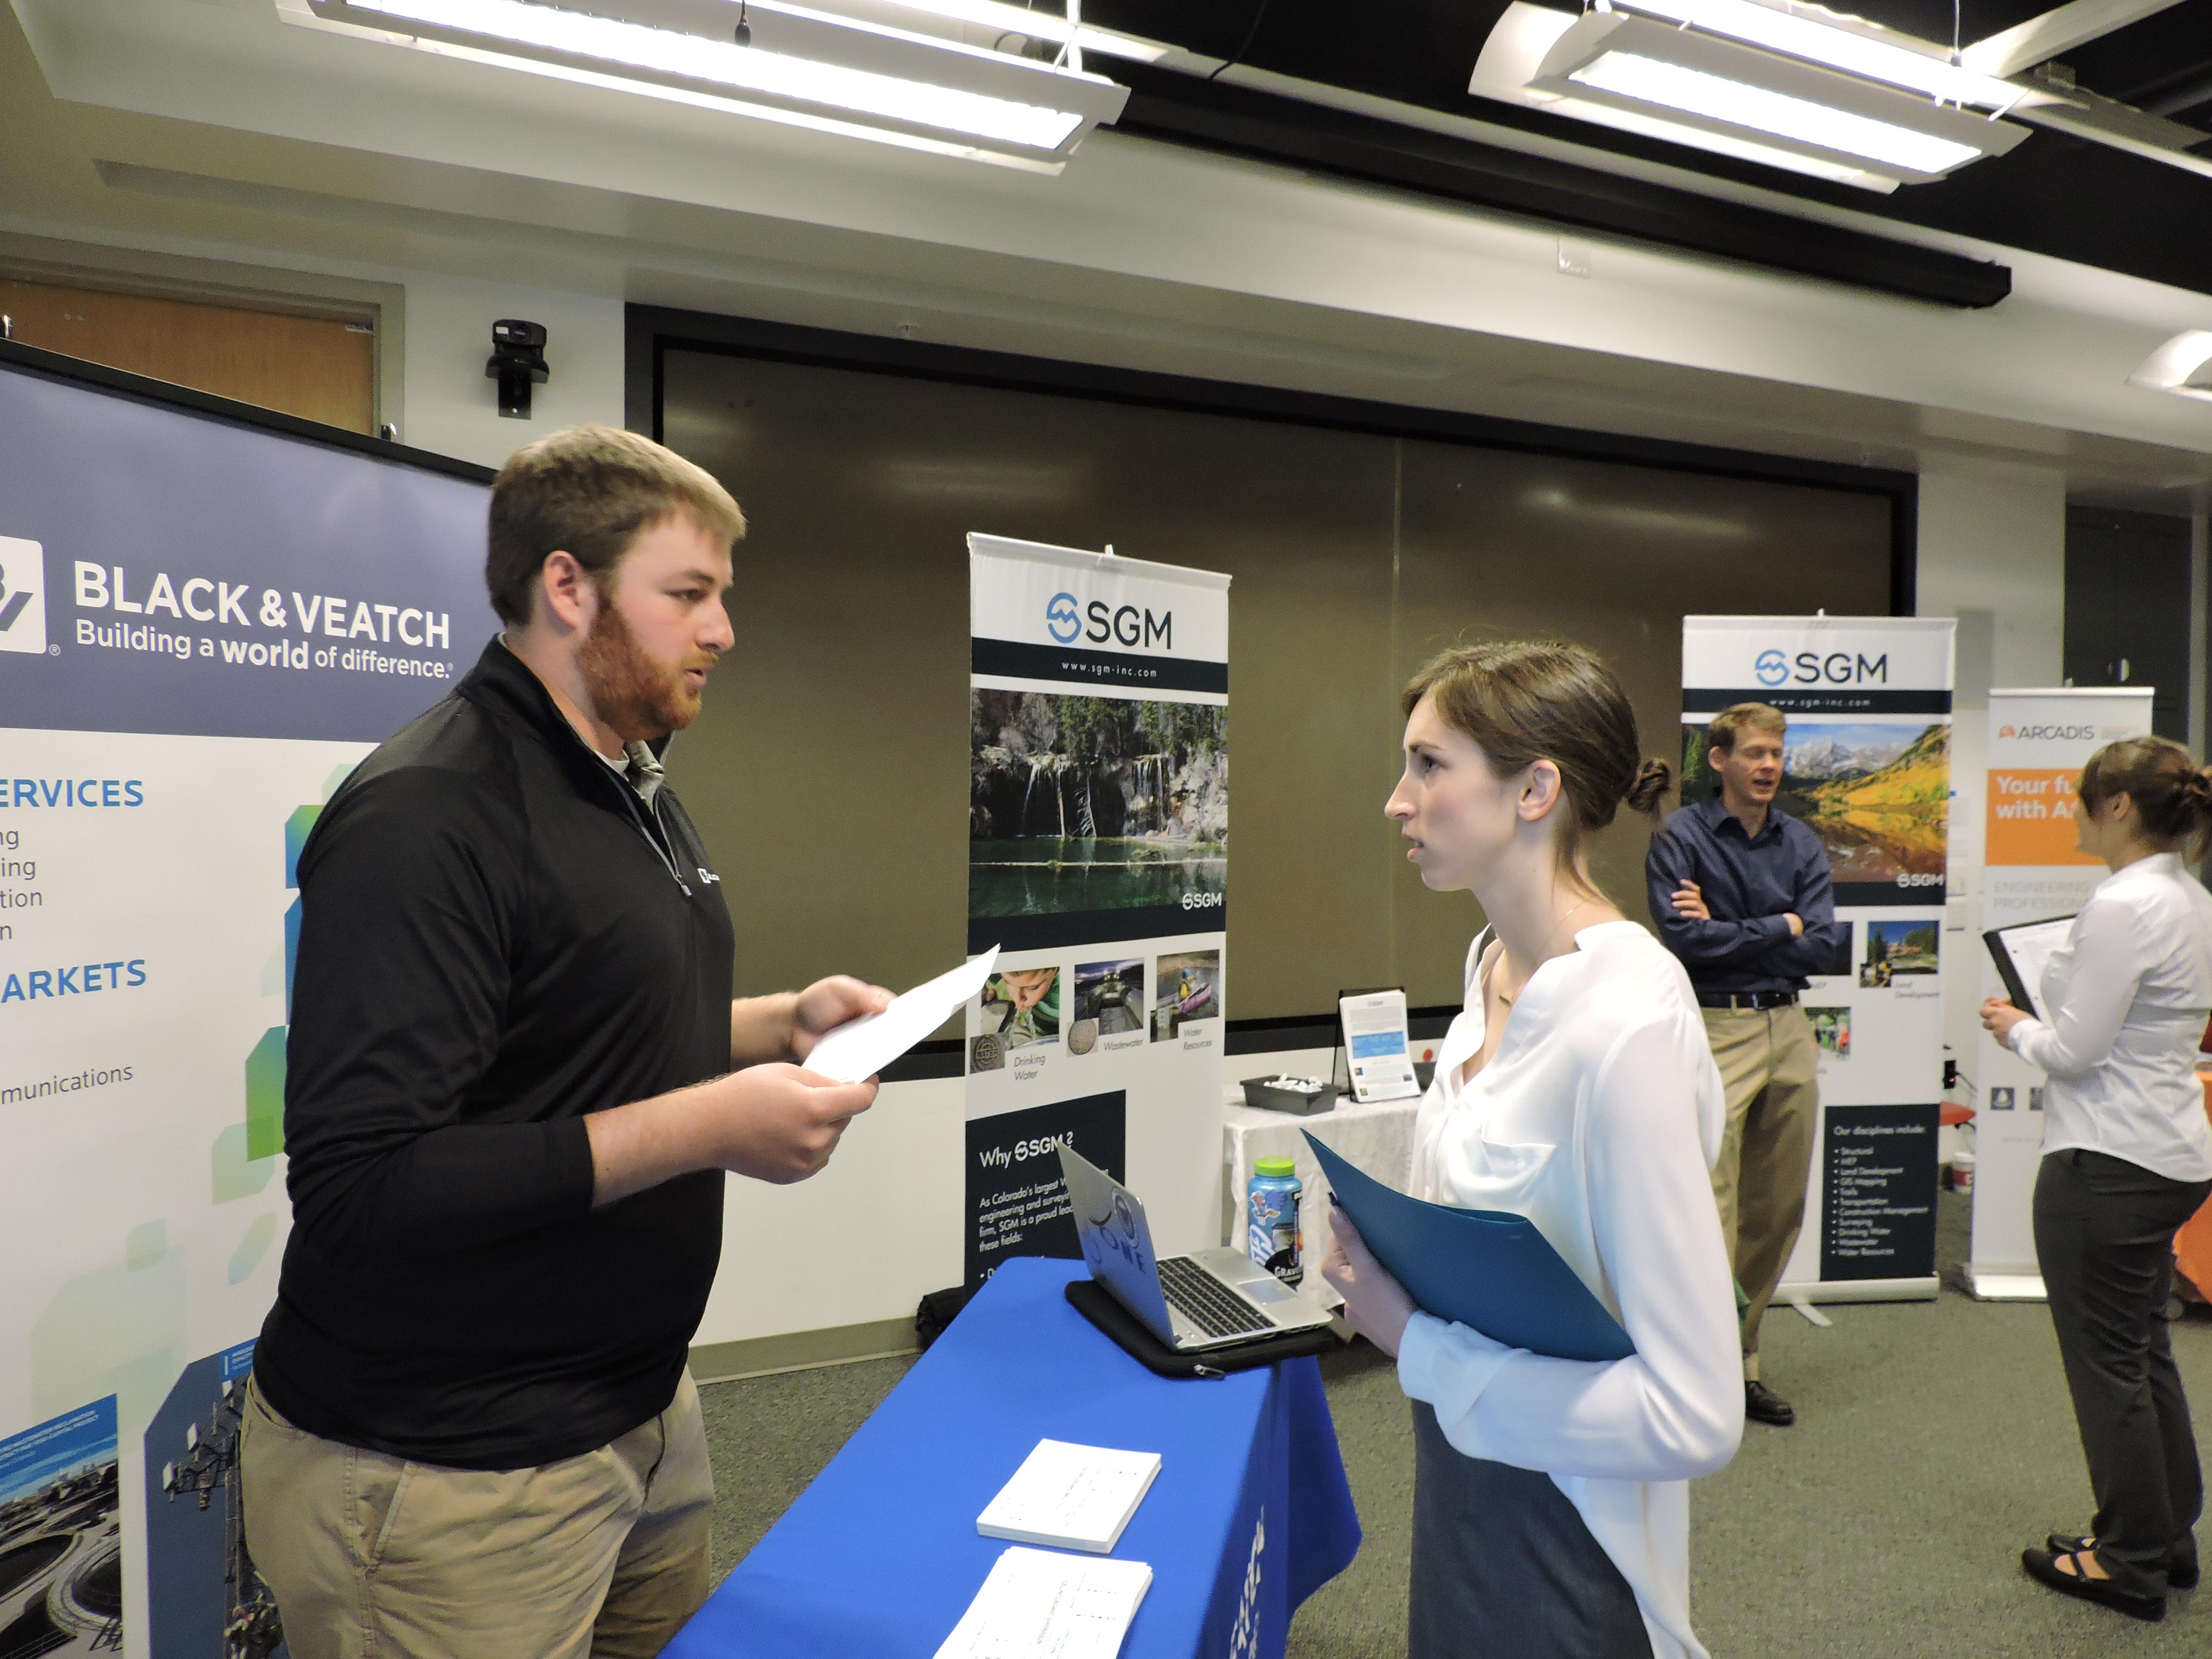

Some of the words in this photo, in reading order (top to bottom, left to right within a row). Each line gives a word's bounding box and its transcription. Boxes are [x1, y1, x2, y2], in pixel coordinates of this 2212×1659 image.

[74, 560, 251, 626] BLACK
[260, 589, 288, 628] &
[292, 592, 450, 649] VEATCH
[1086, 601, 1172, 649] SGM
[76, 619, 192, 659] Building
[199, 637, 214, 657] a
[220, 640, 309, 670] world
[314, 646, 337, 668] of
[1062, 661, 1157, 678] www.sgm-inc.com
[1794, 653, 1887, 684] SGM
[2018, 725, 2095, 740] ARCADIS
[1996, 776, 2049, 794] Your
[1996, 800, 2047, 818] with
[1193, 892, 1222, 908] SGM
[1, 960, 146, 1003] ARKETS
[1184, 1028, 1202, 1037] Water
[1104, 1039, 1143, 1050] Wastewater
[1183, 1040, 1212, 1050] Resources
[1014, 1054, 1046, 1067] Drinking
[1014, 1070, 1038, 1081] Water
[1, 1065, 133, 1105] munications
[979, 1146, 1012, 1169] Why
[979, 1198, 991, 1208] As
[992, 1186, 1033, 1205] Colorado's
[1034, 1179, 1058, 1194] largest
[979, 1204, 1024, 1223] engineering
[1026, 1196, 1041, 1211] and
[999, 1218, 1019, 1232] SGM
[1021, 1216, 1027, 1226] is
[1036, 1205, 1057, 1225] proud
[979, 1240, 999, 1252] these
